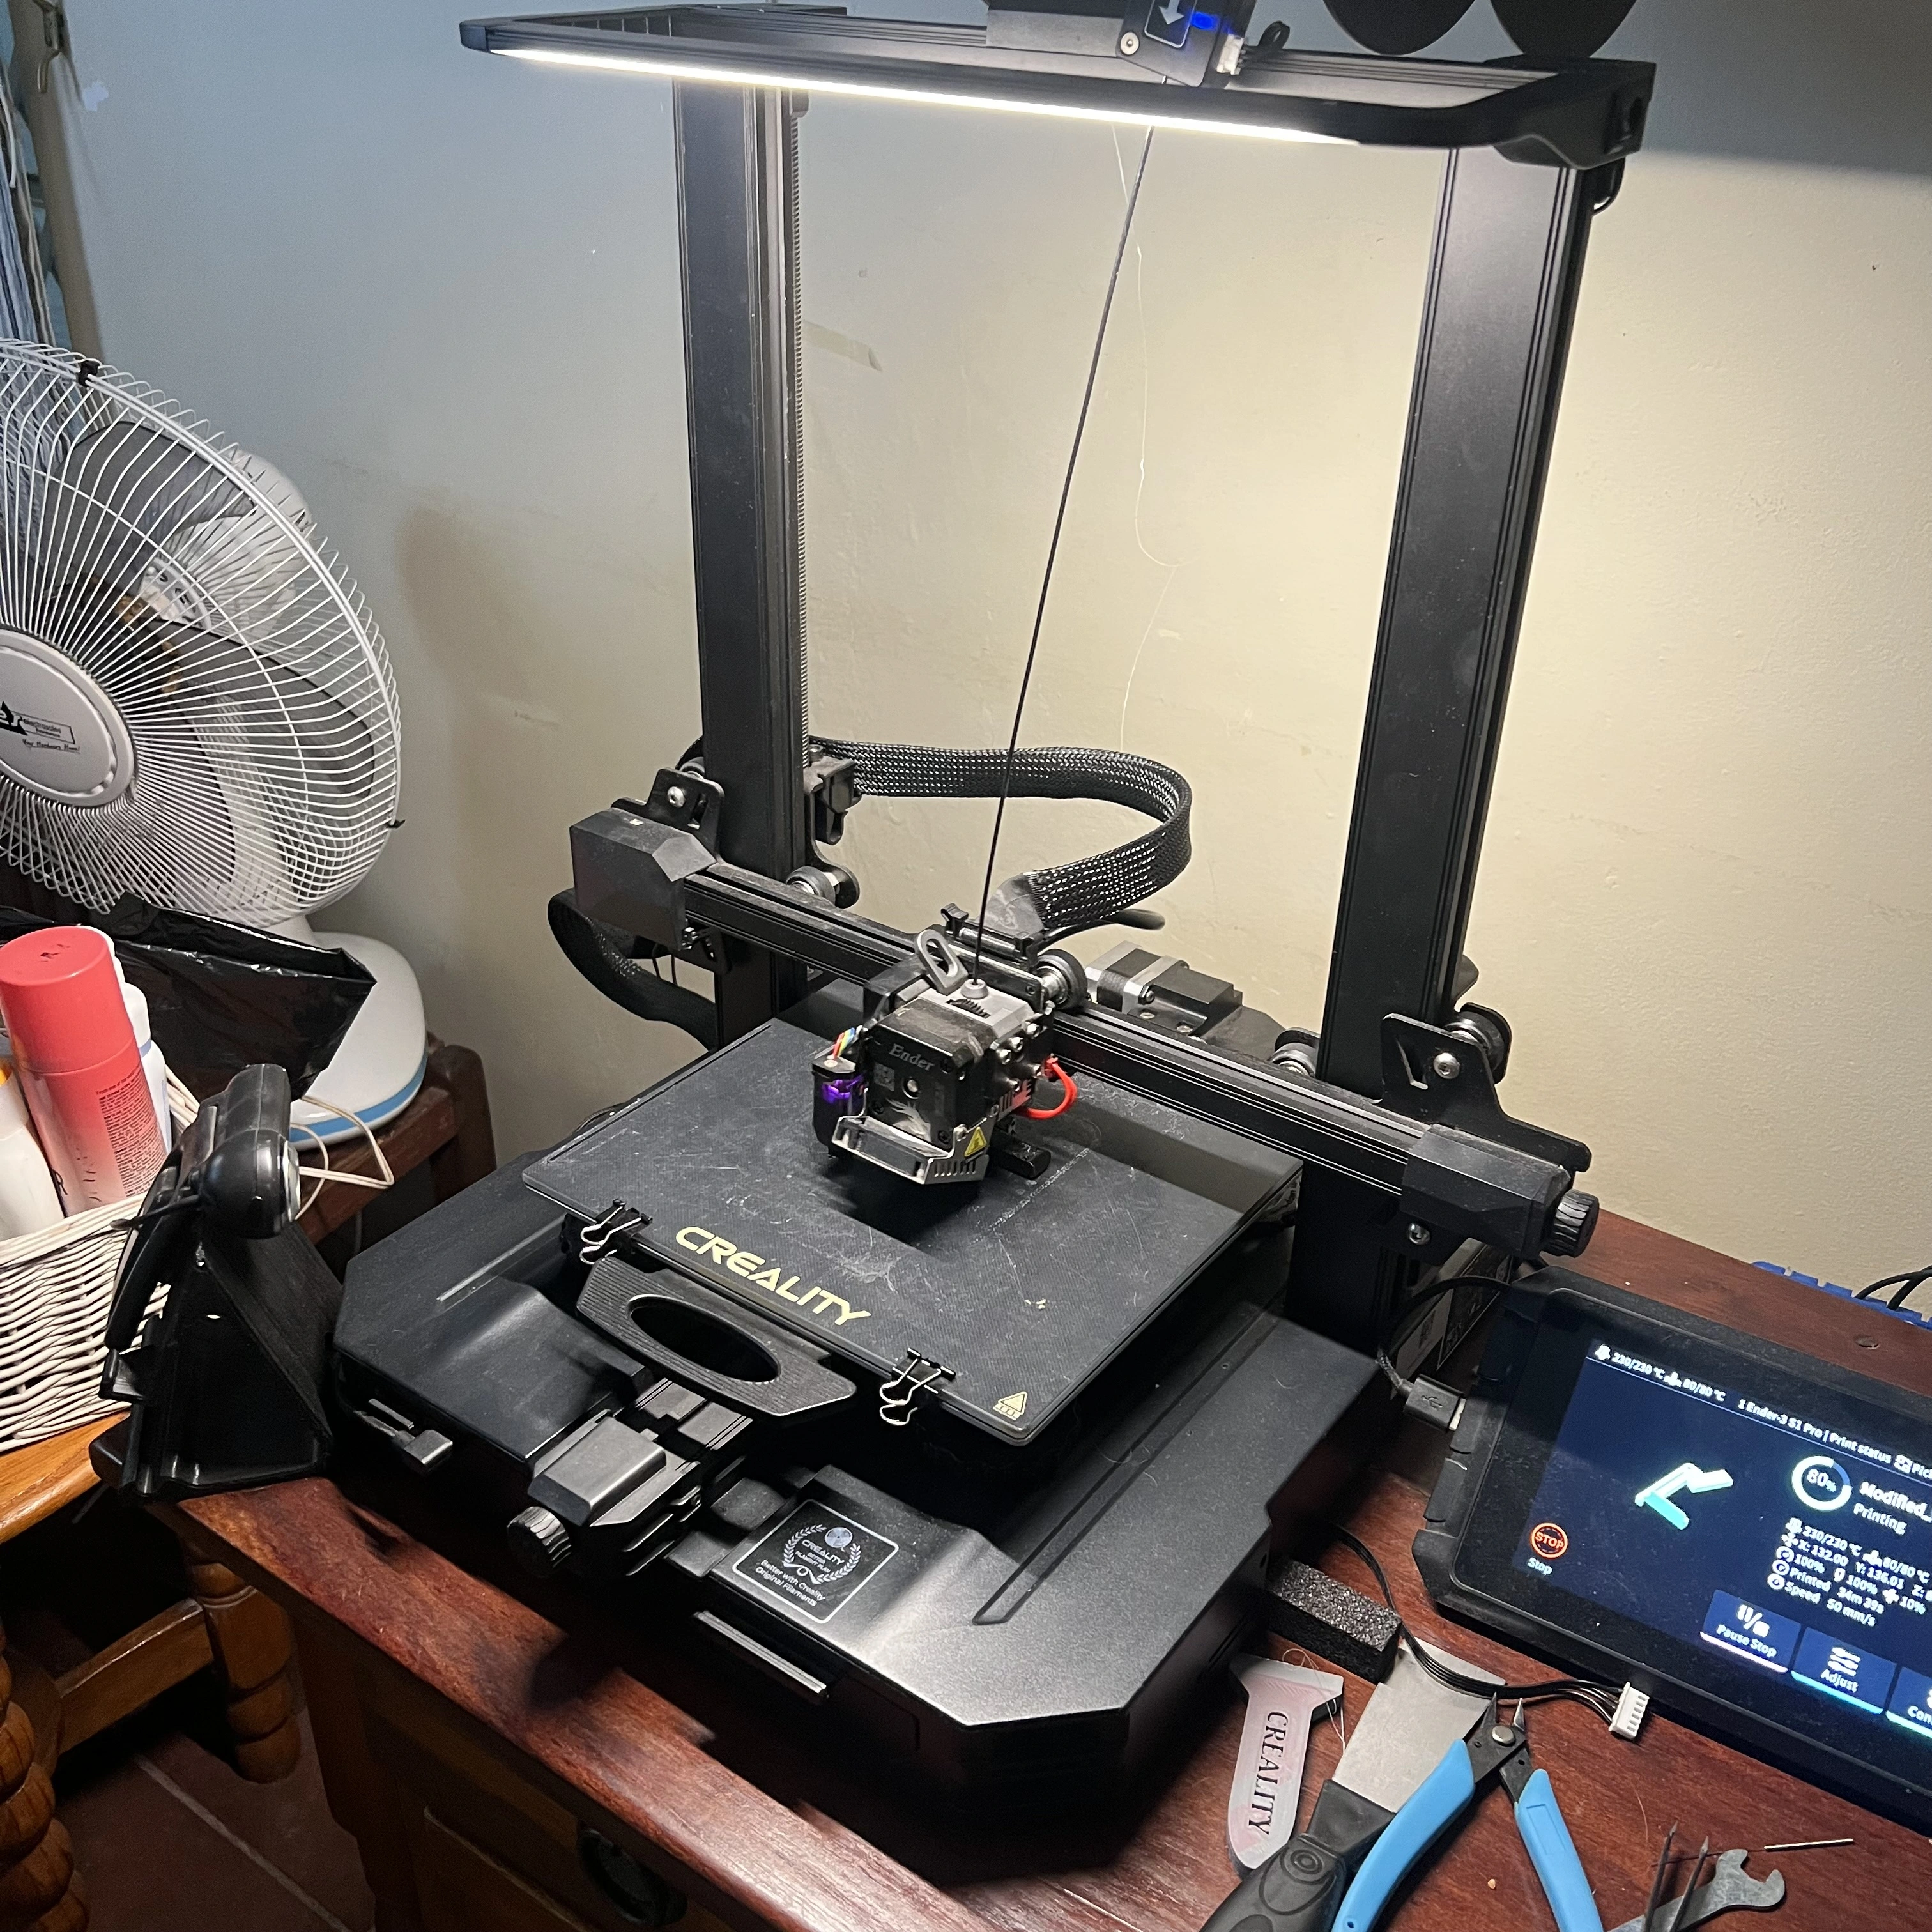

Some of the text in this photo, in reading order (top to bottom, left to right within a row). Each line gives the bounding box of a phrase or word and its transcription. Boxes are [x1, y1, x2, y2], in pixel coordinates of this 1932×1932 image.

[889, 1043, 935, 1071] Ender
[675, 1226, 871, 1326] CREALITY
[1611, 1352, 1652, 1374] 230/230
[1683, 1379, 1713, 1397] 80/80
[1746, 1402, 1788, 1425] Ender-3
[1788, 1416, 1802, 1431] S1
[1803, 1423, 1823, 1438] Pro
[1829, 1432, 1858, 1451] Print
[1858, 1444, 1892, 1464] status
[1807, 1469, 1837, 1492] 80%
[1853, 1503, 1908, 1536] Printing
[1860, 1481, 1932, 1523] Modified_
[802, 1539, 845, 1565] CREALITY
[1535, 1531, 1565, 1549] STOP
[1802, 1526, 1848, 1551] 230/230
[1882, 1557, 1916, 1578] 80/80
[756, 1567, 818, 1606] Original Filaments
[761, 1560, 826, 1601] Better with Creality
[1528, 1557, 1552, 1575] Stop
[1794, 1554, 1826, 1574] 100%
[1846, 1574, 1878, 1595] 100%
[1899, 1595, 1926, 1614] 10%
[1811, 1545, 1849, 1567] 132.00
[1867, 1567, 1905, 1590] 136.01
[1784, 1581, 1877, 1627] Speed 50 mm/s
[1790, 1567, 1885, 1614] Printed 34m 39s
[1716, 1624, 1777, 1659] Pause Stop
[1820, 1669, 1859, 1693] Adjust
[1908, 1705, 1932, 1725] Con
[1248, 1712, 1289, 1835] CREALITY
